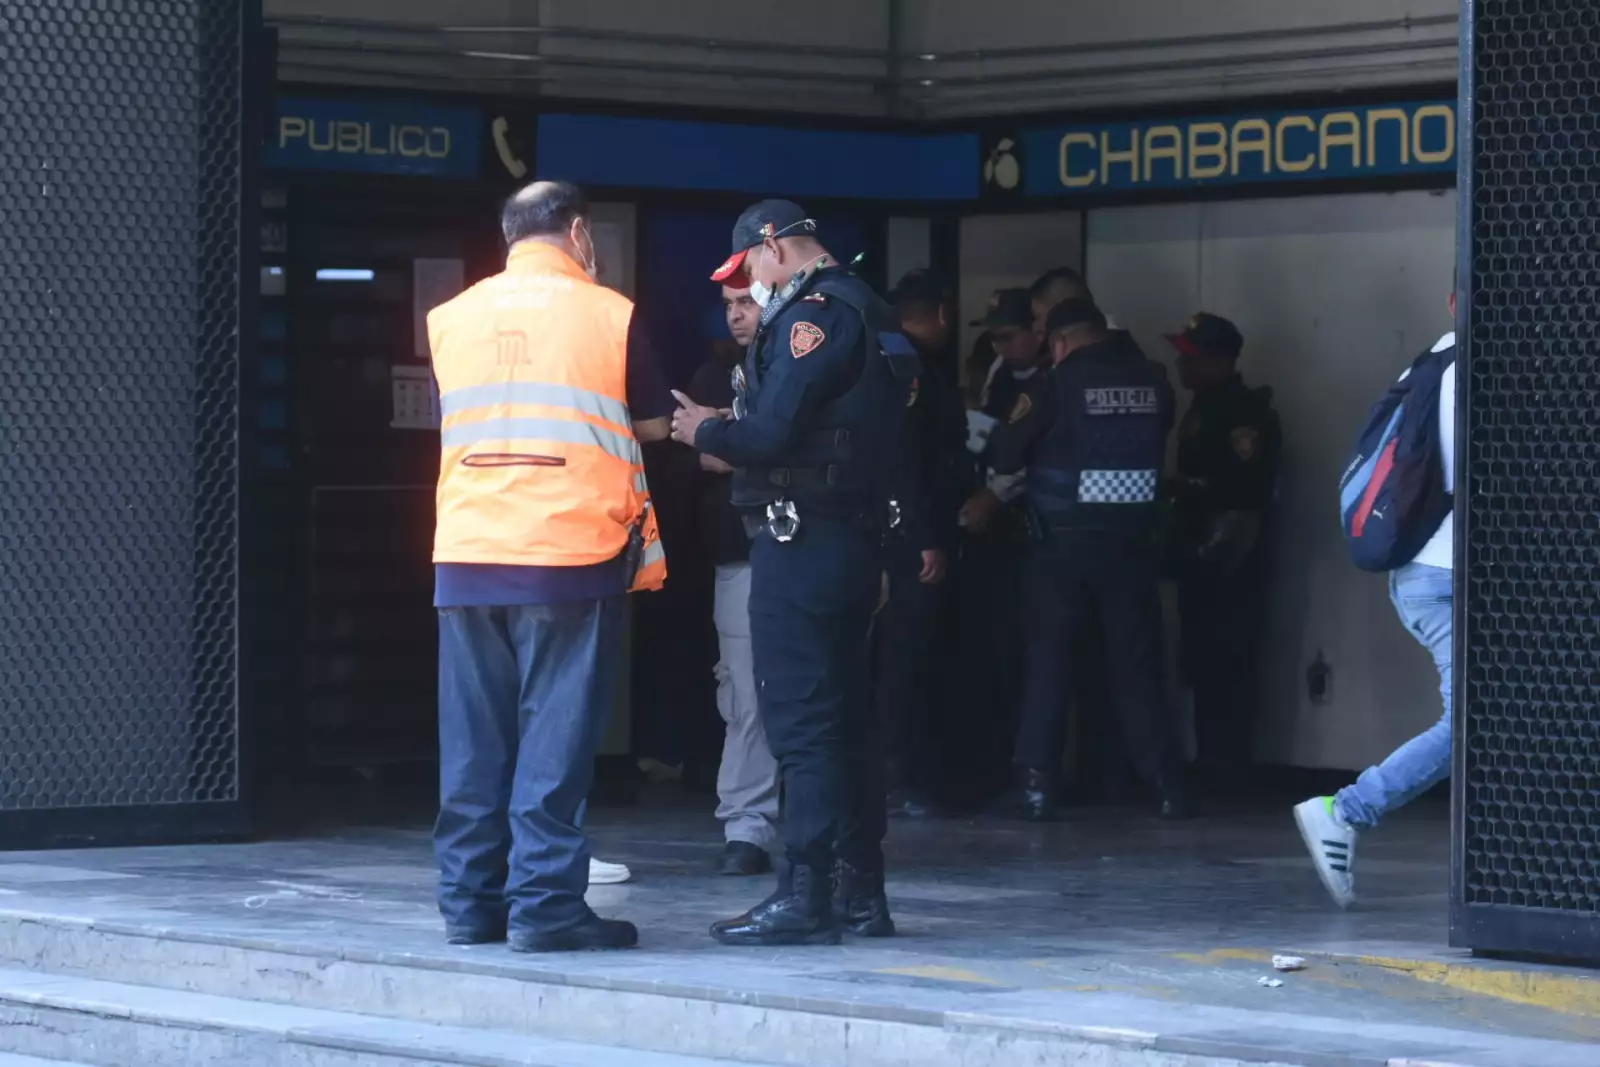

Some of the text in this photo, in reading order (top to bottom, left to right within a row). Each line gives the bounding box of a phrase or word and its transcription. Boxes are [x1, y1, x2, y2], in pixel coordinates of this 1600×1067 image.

[279, 116, 451, 158] PUBLICO
[1059, 105, 1455, 187] CHABACANO
[1084, 390, 1157, 405] POLICIA
